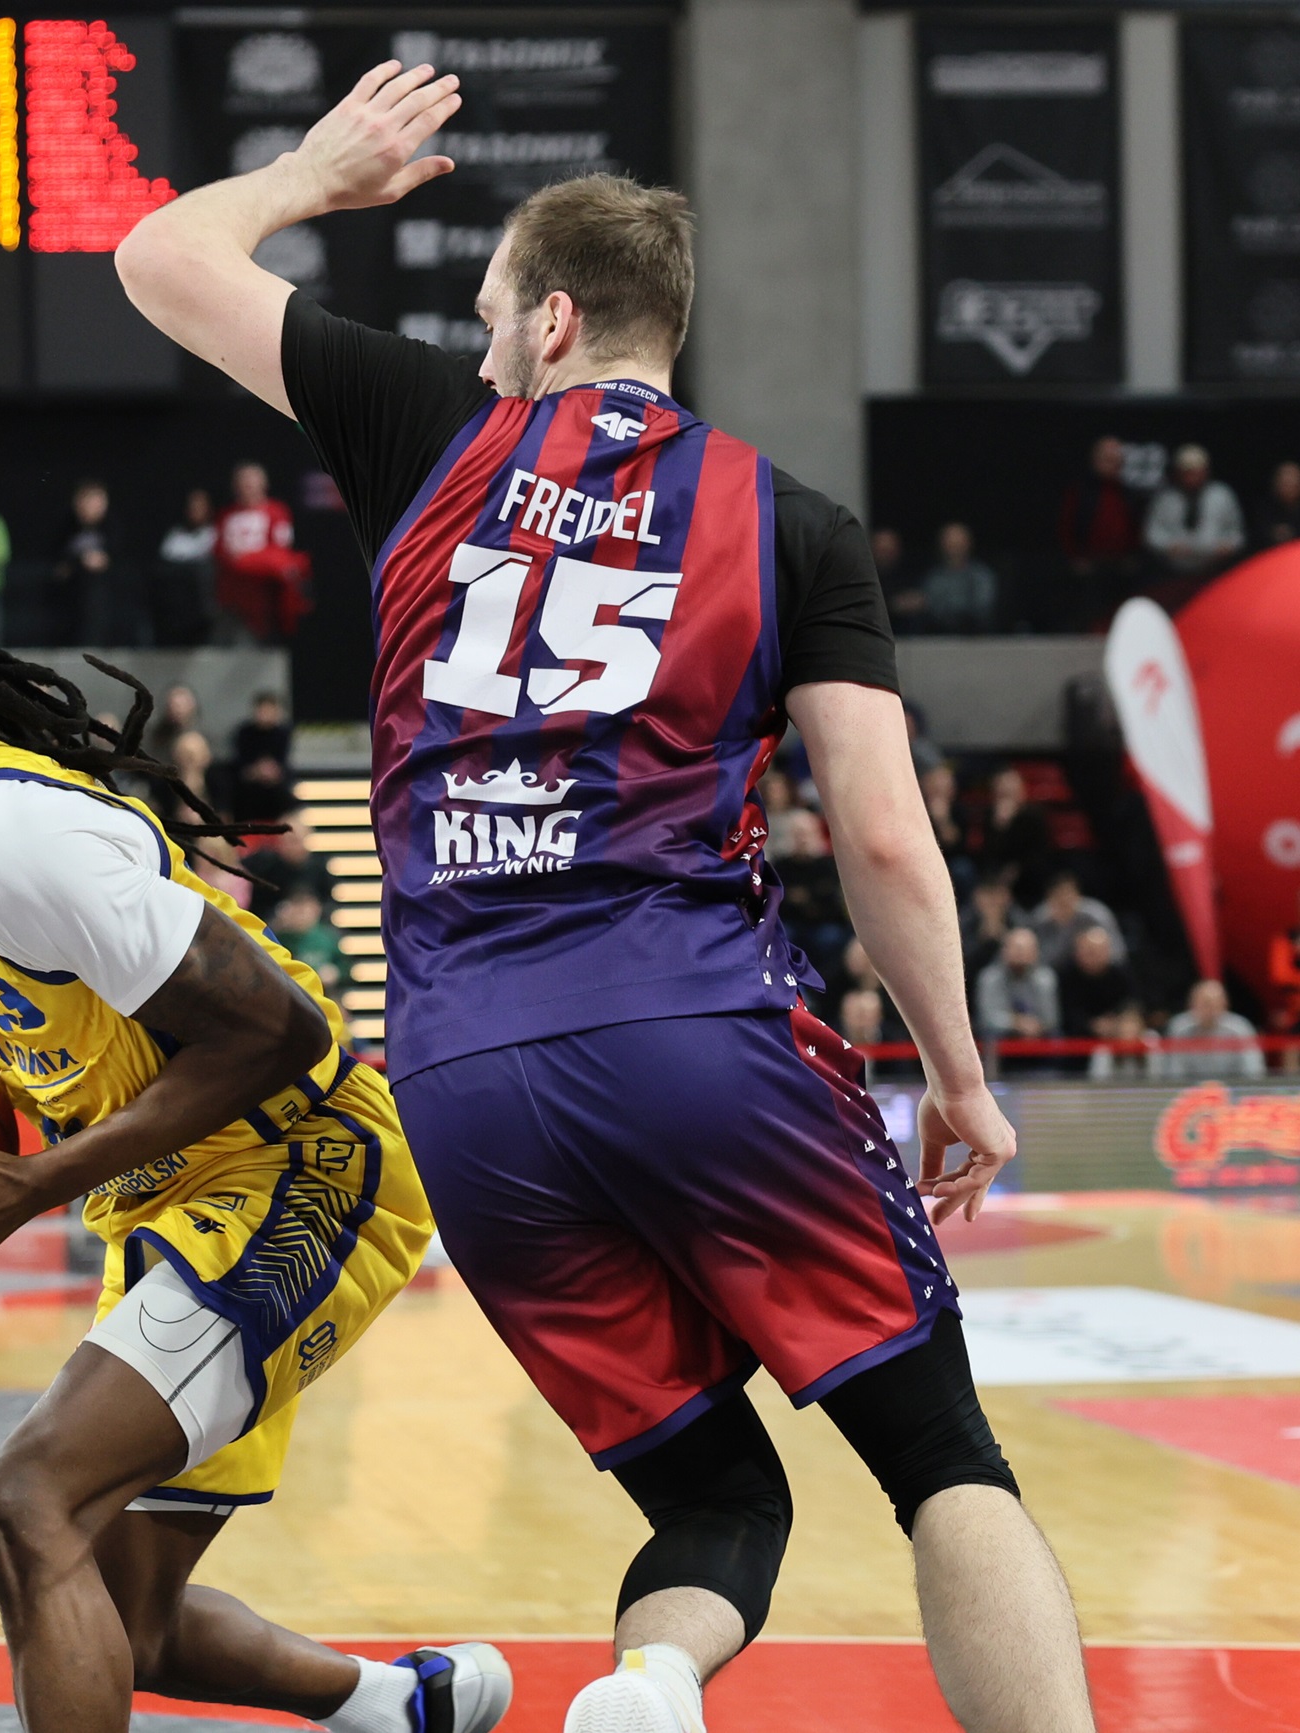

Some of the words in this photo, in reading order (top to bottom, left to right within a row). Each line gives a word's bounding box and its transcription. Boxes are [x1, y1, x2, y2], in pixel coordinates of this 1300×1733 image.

[594, 382, 618, 390] KING
[618, 383, 659, 403] SZCZECIN
[590, 411, 649, 441] 4F
[497, 468, 661, 545] FREIDEL
[422, 543, 684, 718] 15
[432, 809, 584, 866] KING
[110, 1150, 189, 1197] OPOLSKI
